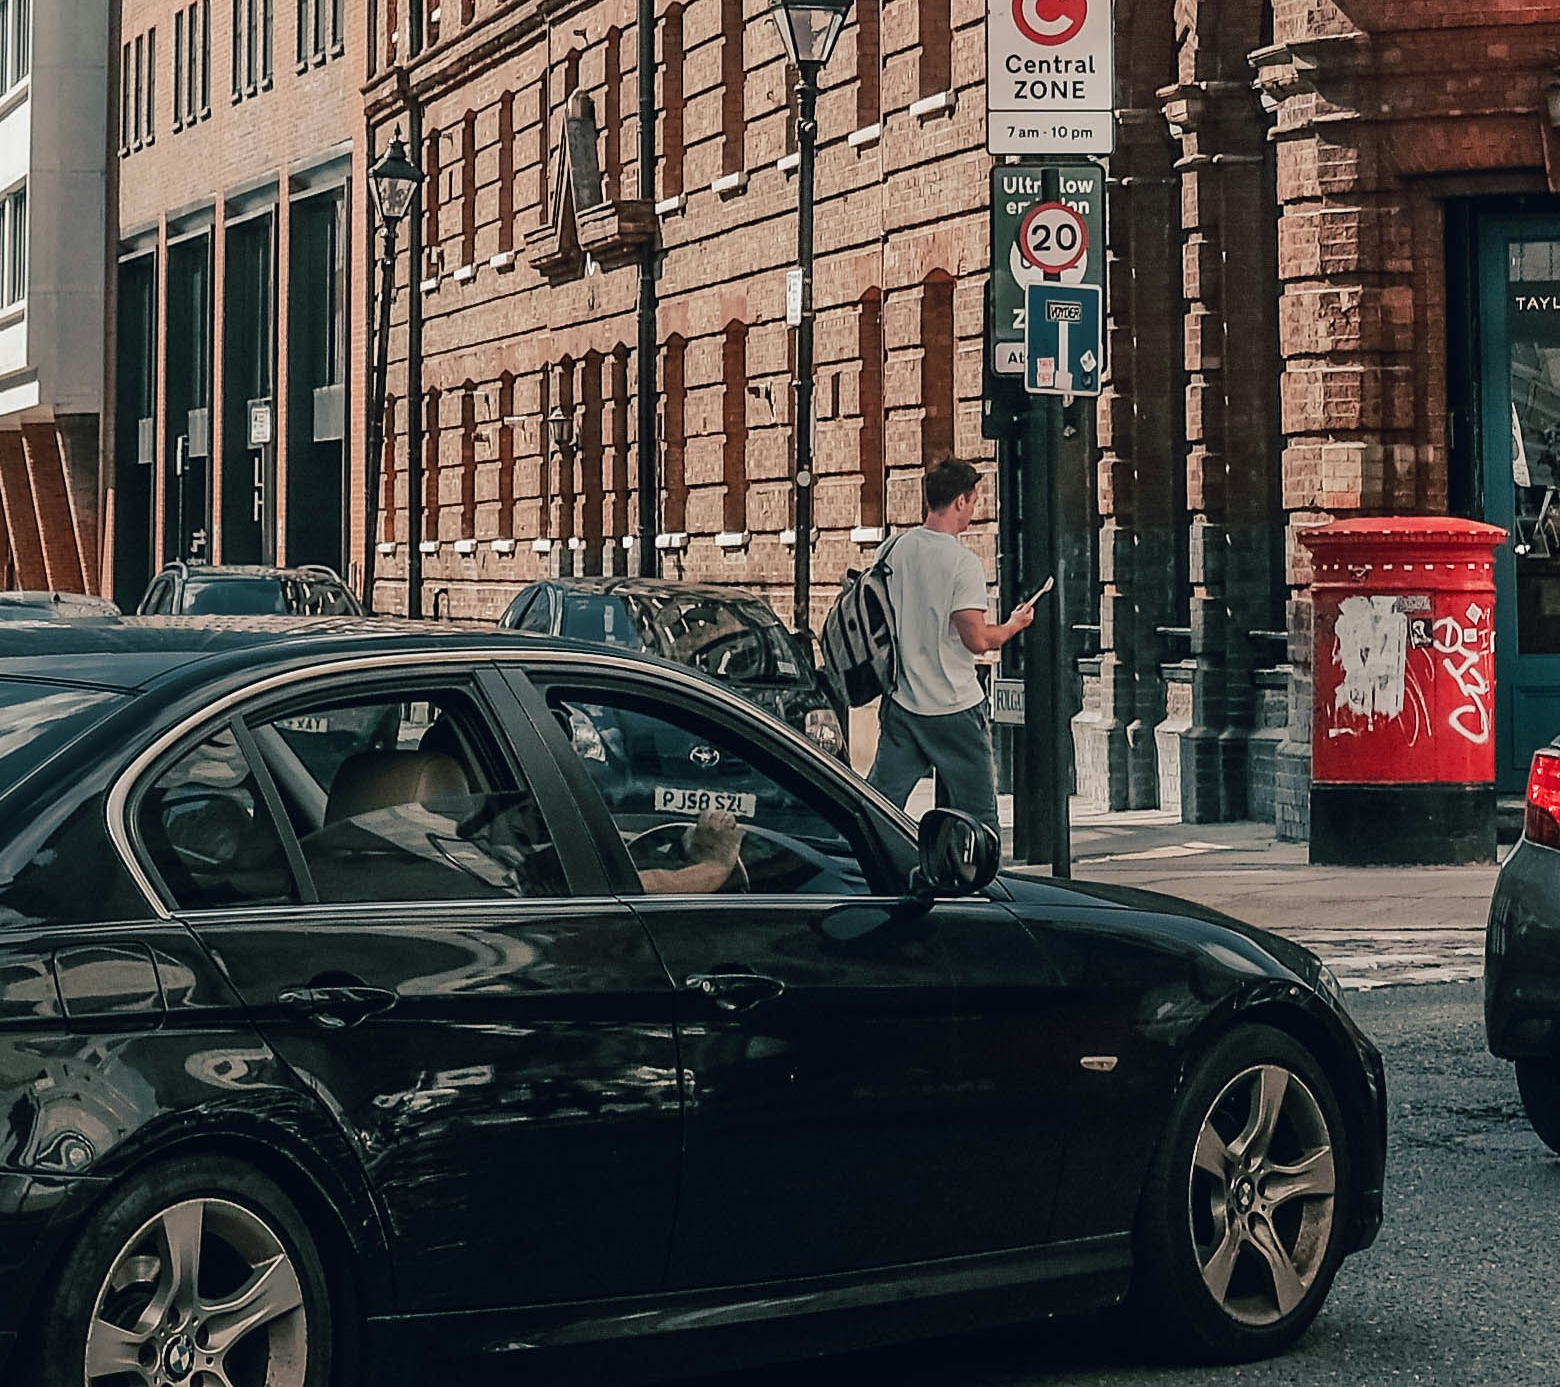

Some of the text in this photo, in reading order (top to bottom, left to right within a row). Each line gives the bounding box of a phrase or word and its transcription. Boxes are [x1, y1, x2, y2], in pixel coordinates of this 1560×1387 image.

[1005, 54, 1096, 74] Central
[1014, 80, 1086, 100] ZONE
[1007, 126, 1016, 138] 7
[1018, 128, 1040, 138] am
[1051, 126, 1068, 138] 10
[1071, 128, 1093, 140] pm
[1002, 176, 1042, 195] Ultr
[1031, 223, 1078, 252] 20
